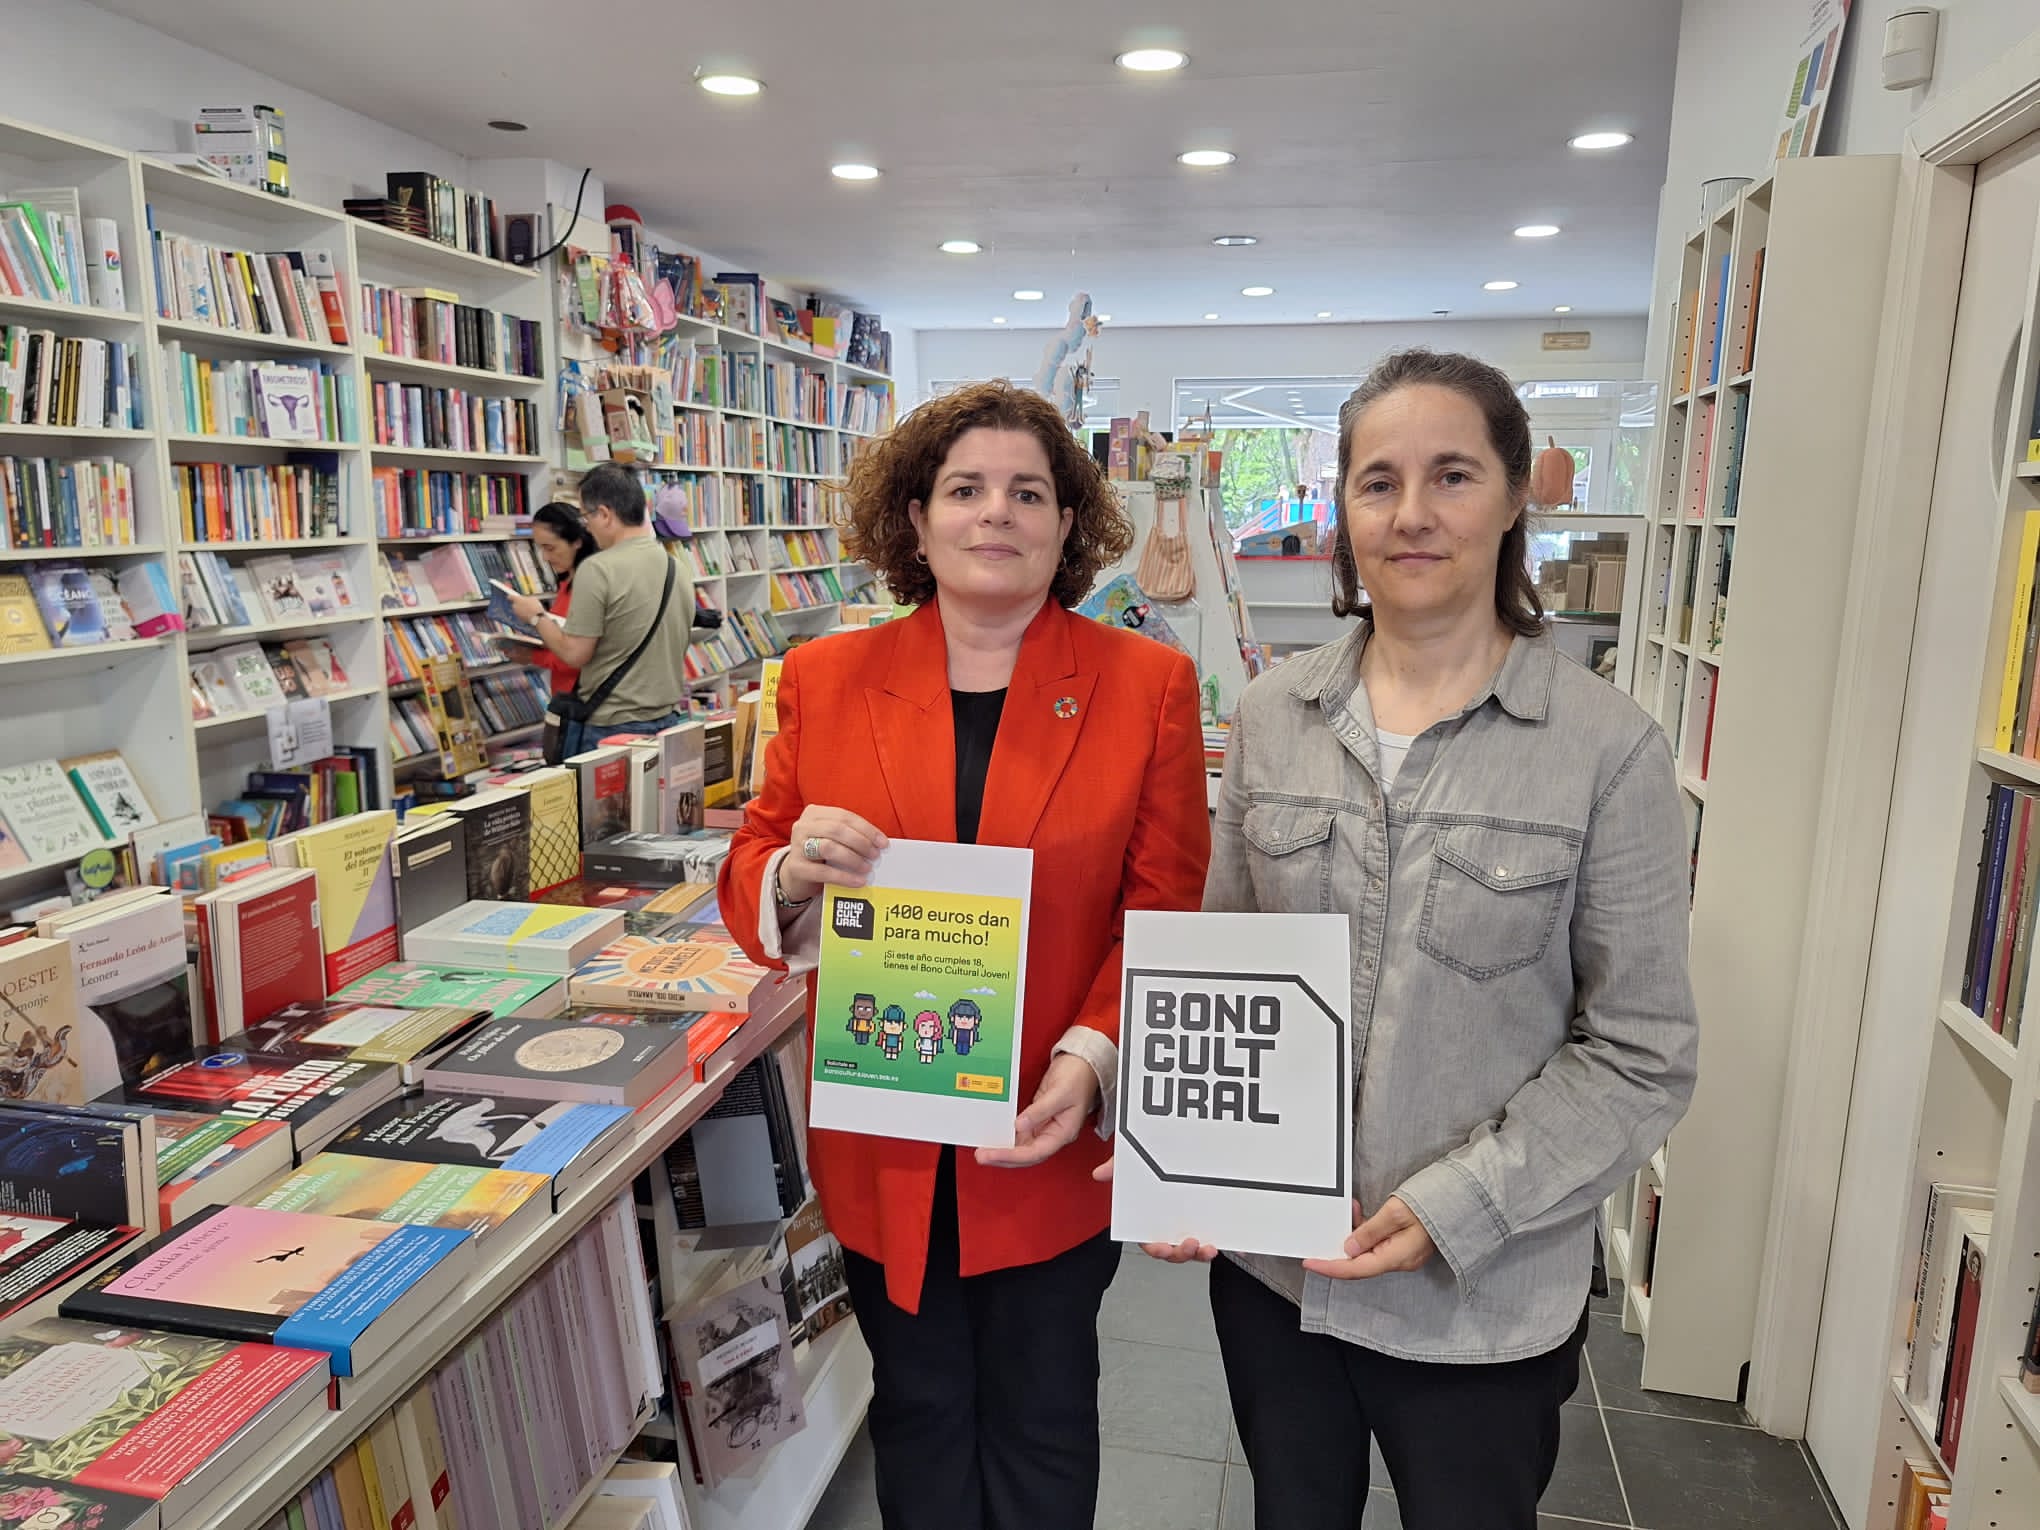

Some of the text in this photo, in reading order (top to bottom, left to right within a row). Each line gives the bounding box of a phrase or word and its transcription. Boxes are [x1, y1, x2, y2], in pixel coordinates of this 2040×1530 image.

[344, 844, 382, 861] El volumen
[345, 862, 358, 872] del
[836, 909, 863, 919] CULT
[837, 901, 864, 911] BONO
[885, 904, 1010, 928] ¡400 euros dan
[836, 918, 862, 928] URAL
[884, 927, 989, 946] para mucho!
[80, 951, 124, 972] Fernando
[126, 944, 146, 961] León
[147, 940, 157, 950] de
[896, 953, 914, 961] este
[917, 952, 933, 962] año
[935, 956, 971, 966] cumples
[973, 959, 985, 967] 18,
[81, 969, 120, 987] Leonera
[884, 962, 1010, 980] tienes el Bono Cultural Joven!
[17, 994, 49, 1014] monje
[1145, 990, 1280, 1035] BONO
[1143, 1033, 1275, 1078] CULT
[221, 1060, 346, 1118] LA PUERTA
[1142, 1075, 1279, 1124] URAL
[364, 1118, 402, 1142] Héctor
[381, 1124, 409, 1144] Abad
[124, 1247, 178, 1290] Claudia
[145, 1281, 165, 1293] La
[166, 1254, 202, 1281] muerte
[107, 1435, 142, 1460] TODOS
[137, 1402, 180, 1435] PODEMOS
[191, 1353, 242, 1390] ESCULTORES
[136, 1412, 180, 1444] NUESTRO
[204, 1359, 245, 1388] CEREBRO
